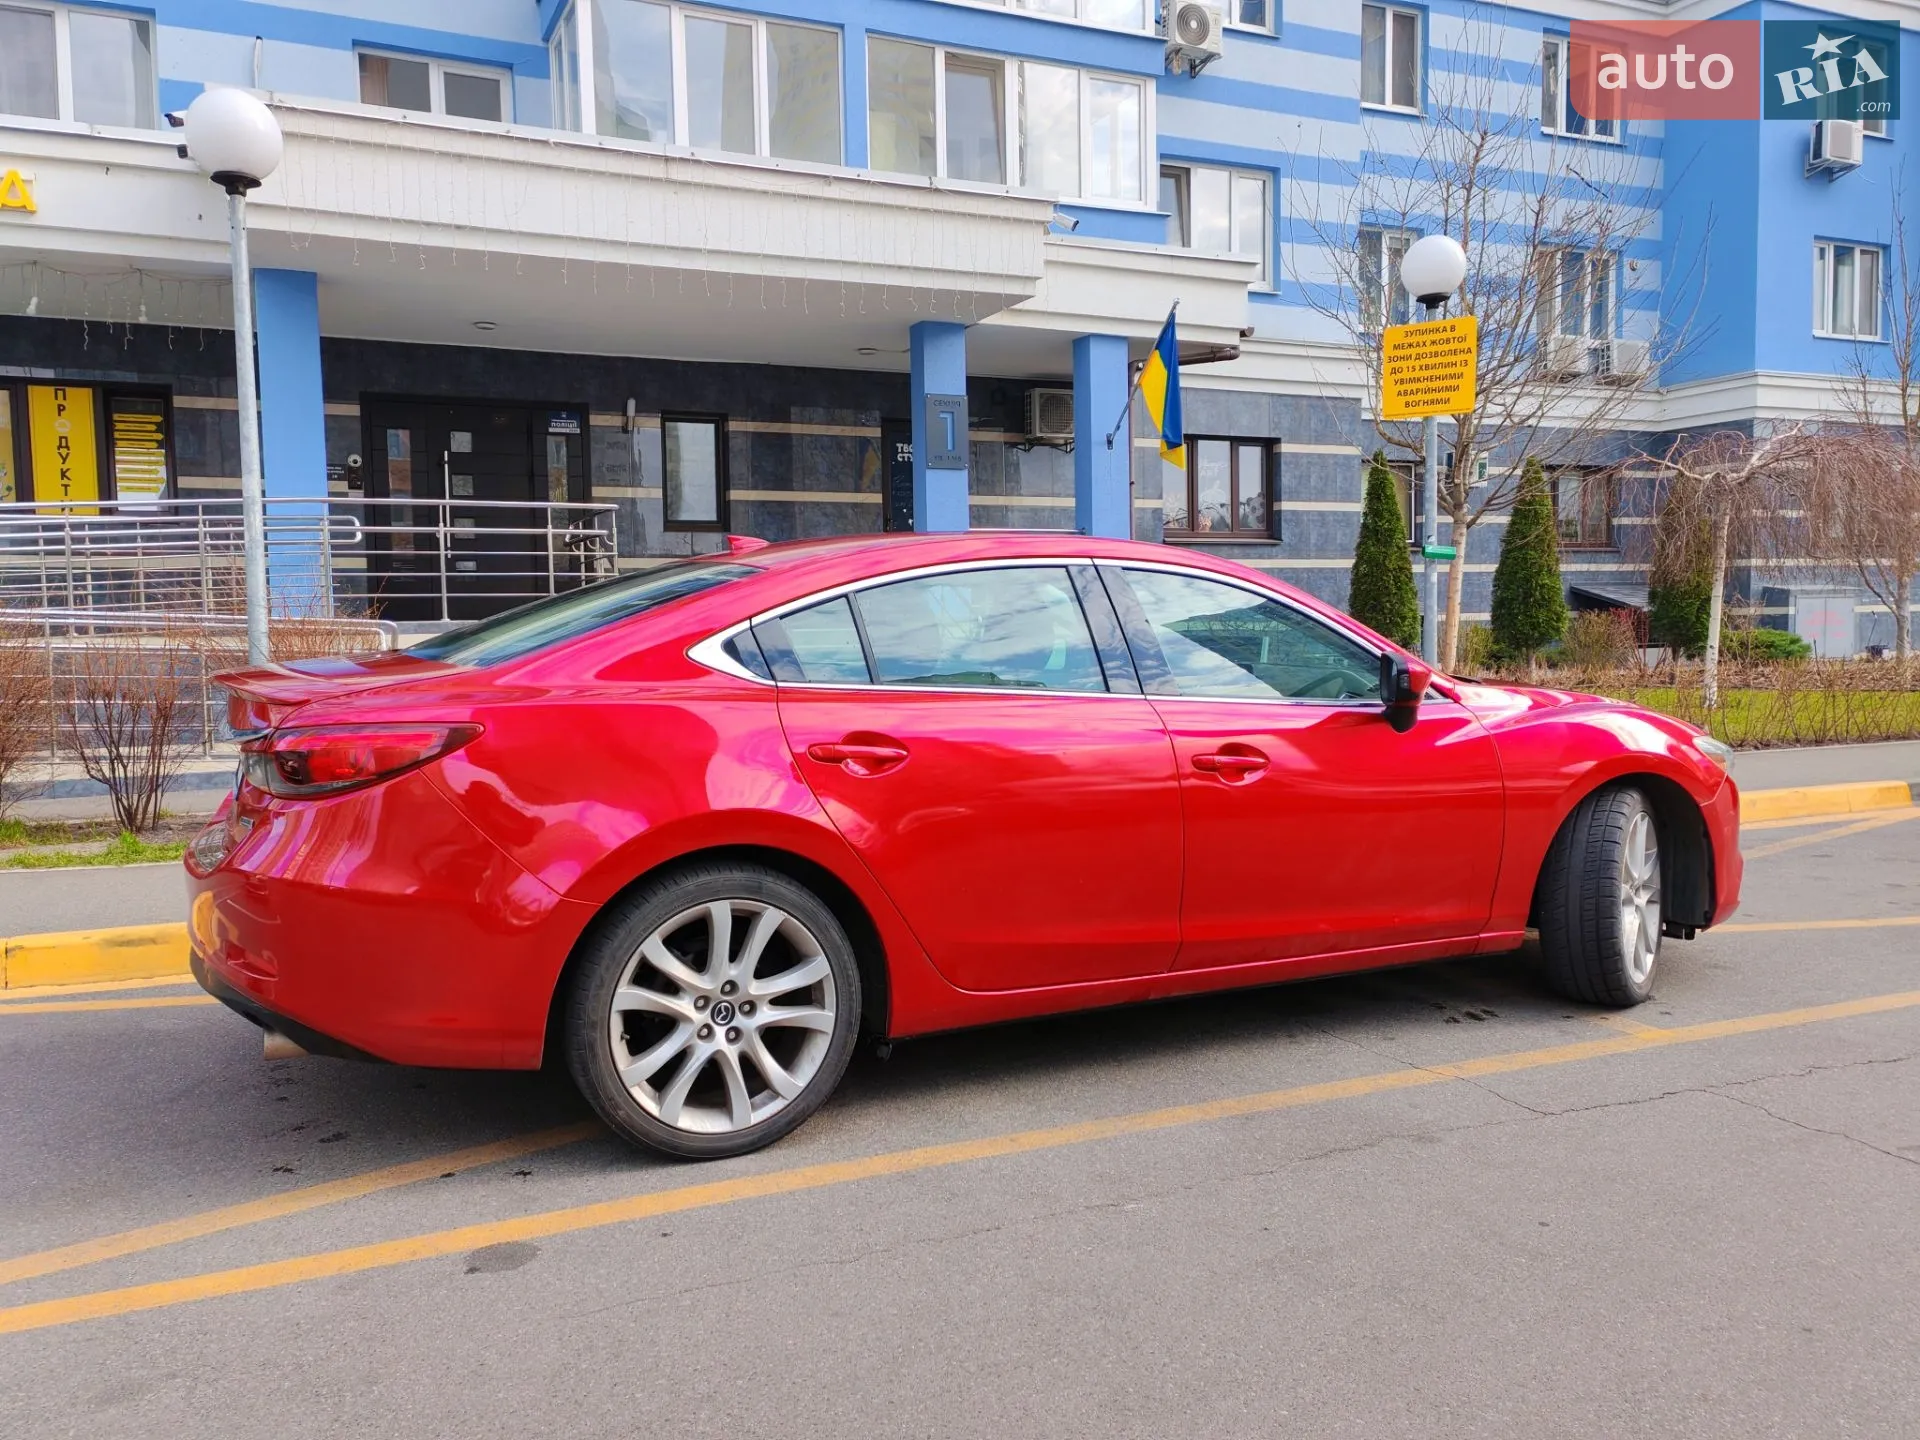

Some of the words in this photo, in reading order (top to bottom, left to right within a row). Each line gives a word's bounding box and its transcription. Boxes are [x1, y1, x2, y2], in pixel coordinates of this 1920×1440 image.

[1403, 326, 1448, 338] ЗУПИНКА
[1393, 341, 1427, 351] МЕЖАХ
[1429, 334, 1467, 346] ЖОВТОЇ
[1387, 354, 1413, 364] ЗОНИ
[1414, 347, 1472, 361] ДОЗВОЛЕНА
[1390, 366, 1404, 377] ДО
[1406, 364, 1417, 373] 15
[1418, 361, 1458, 372] ХВИЛИН
[1459, 359, 1469, 368] ІЗ
[1394, 372, 1463, 386] УВІМКНЕНИМИ
[1396, 385, 1460, 397] АВАРІЙНИМИ
[1404, 397, 1450, 408] ВОГНЯМИ
[938, 411, 955, 451] 1
